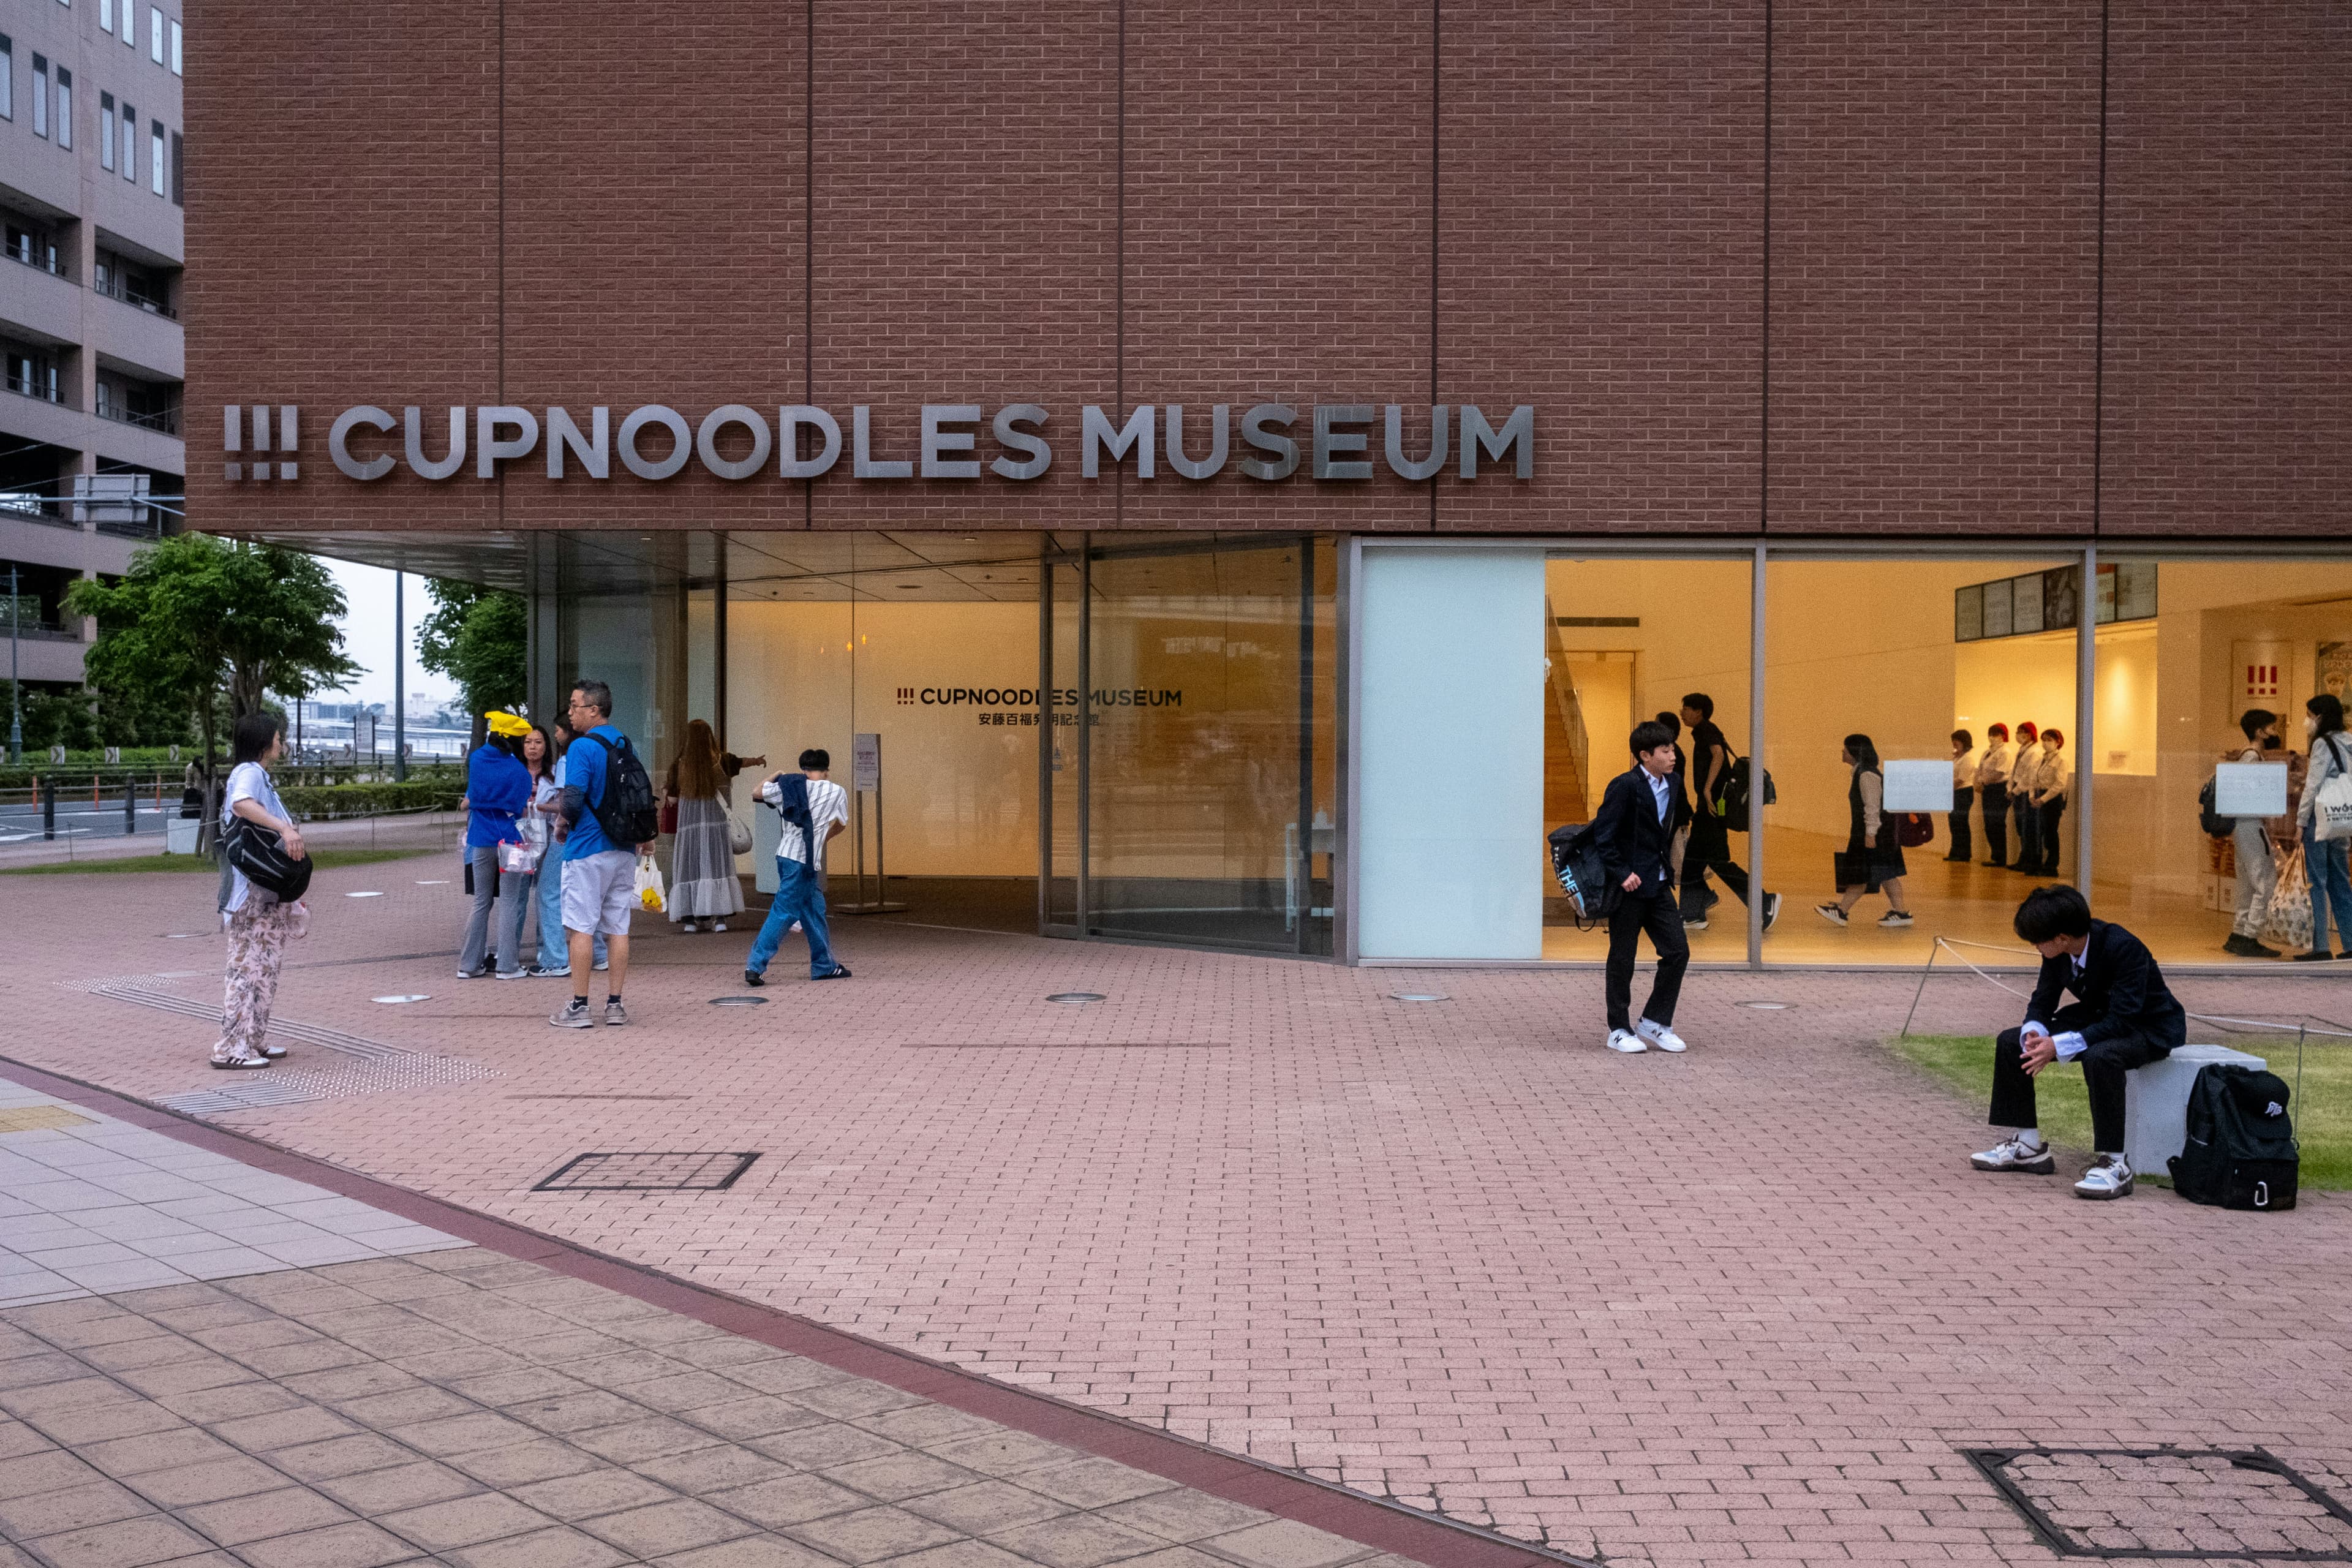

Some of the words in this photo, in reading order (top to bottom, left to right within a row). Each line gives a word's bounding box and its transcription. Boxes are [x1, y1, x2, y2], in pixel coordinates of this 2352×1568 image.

[328, 404, 1052, 481] CUPNOODLES
[1082, 404, 1534, 480] MUSEUM
[1559, 864, 1580, 895] THE
